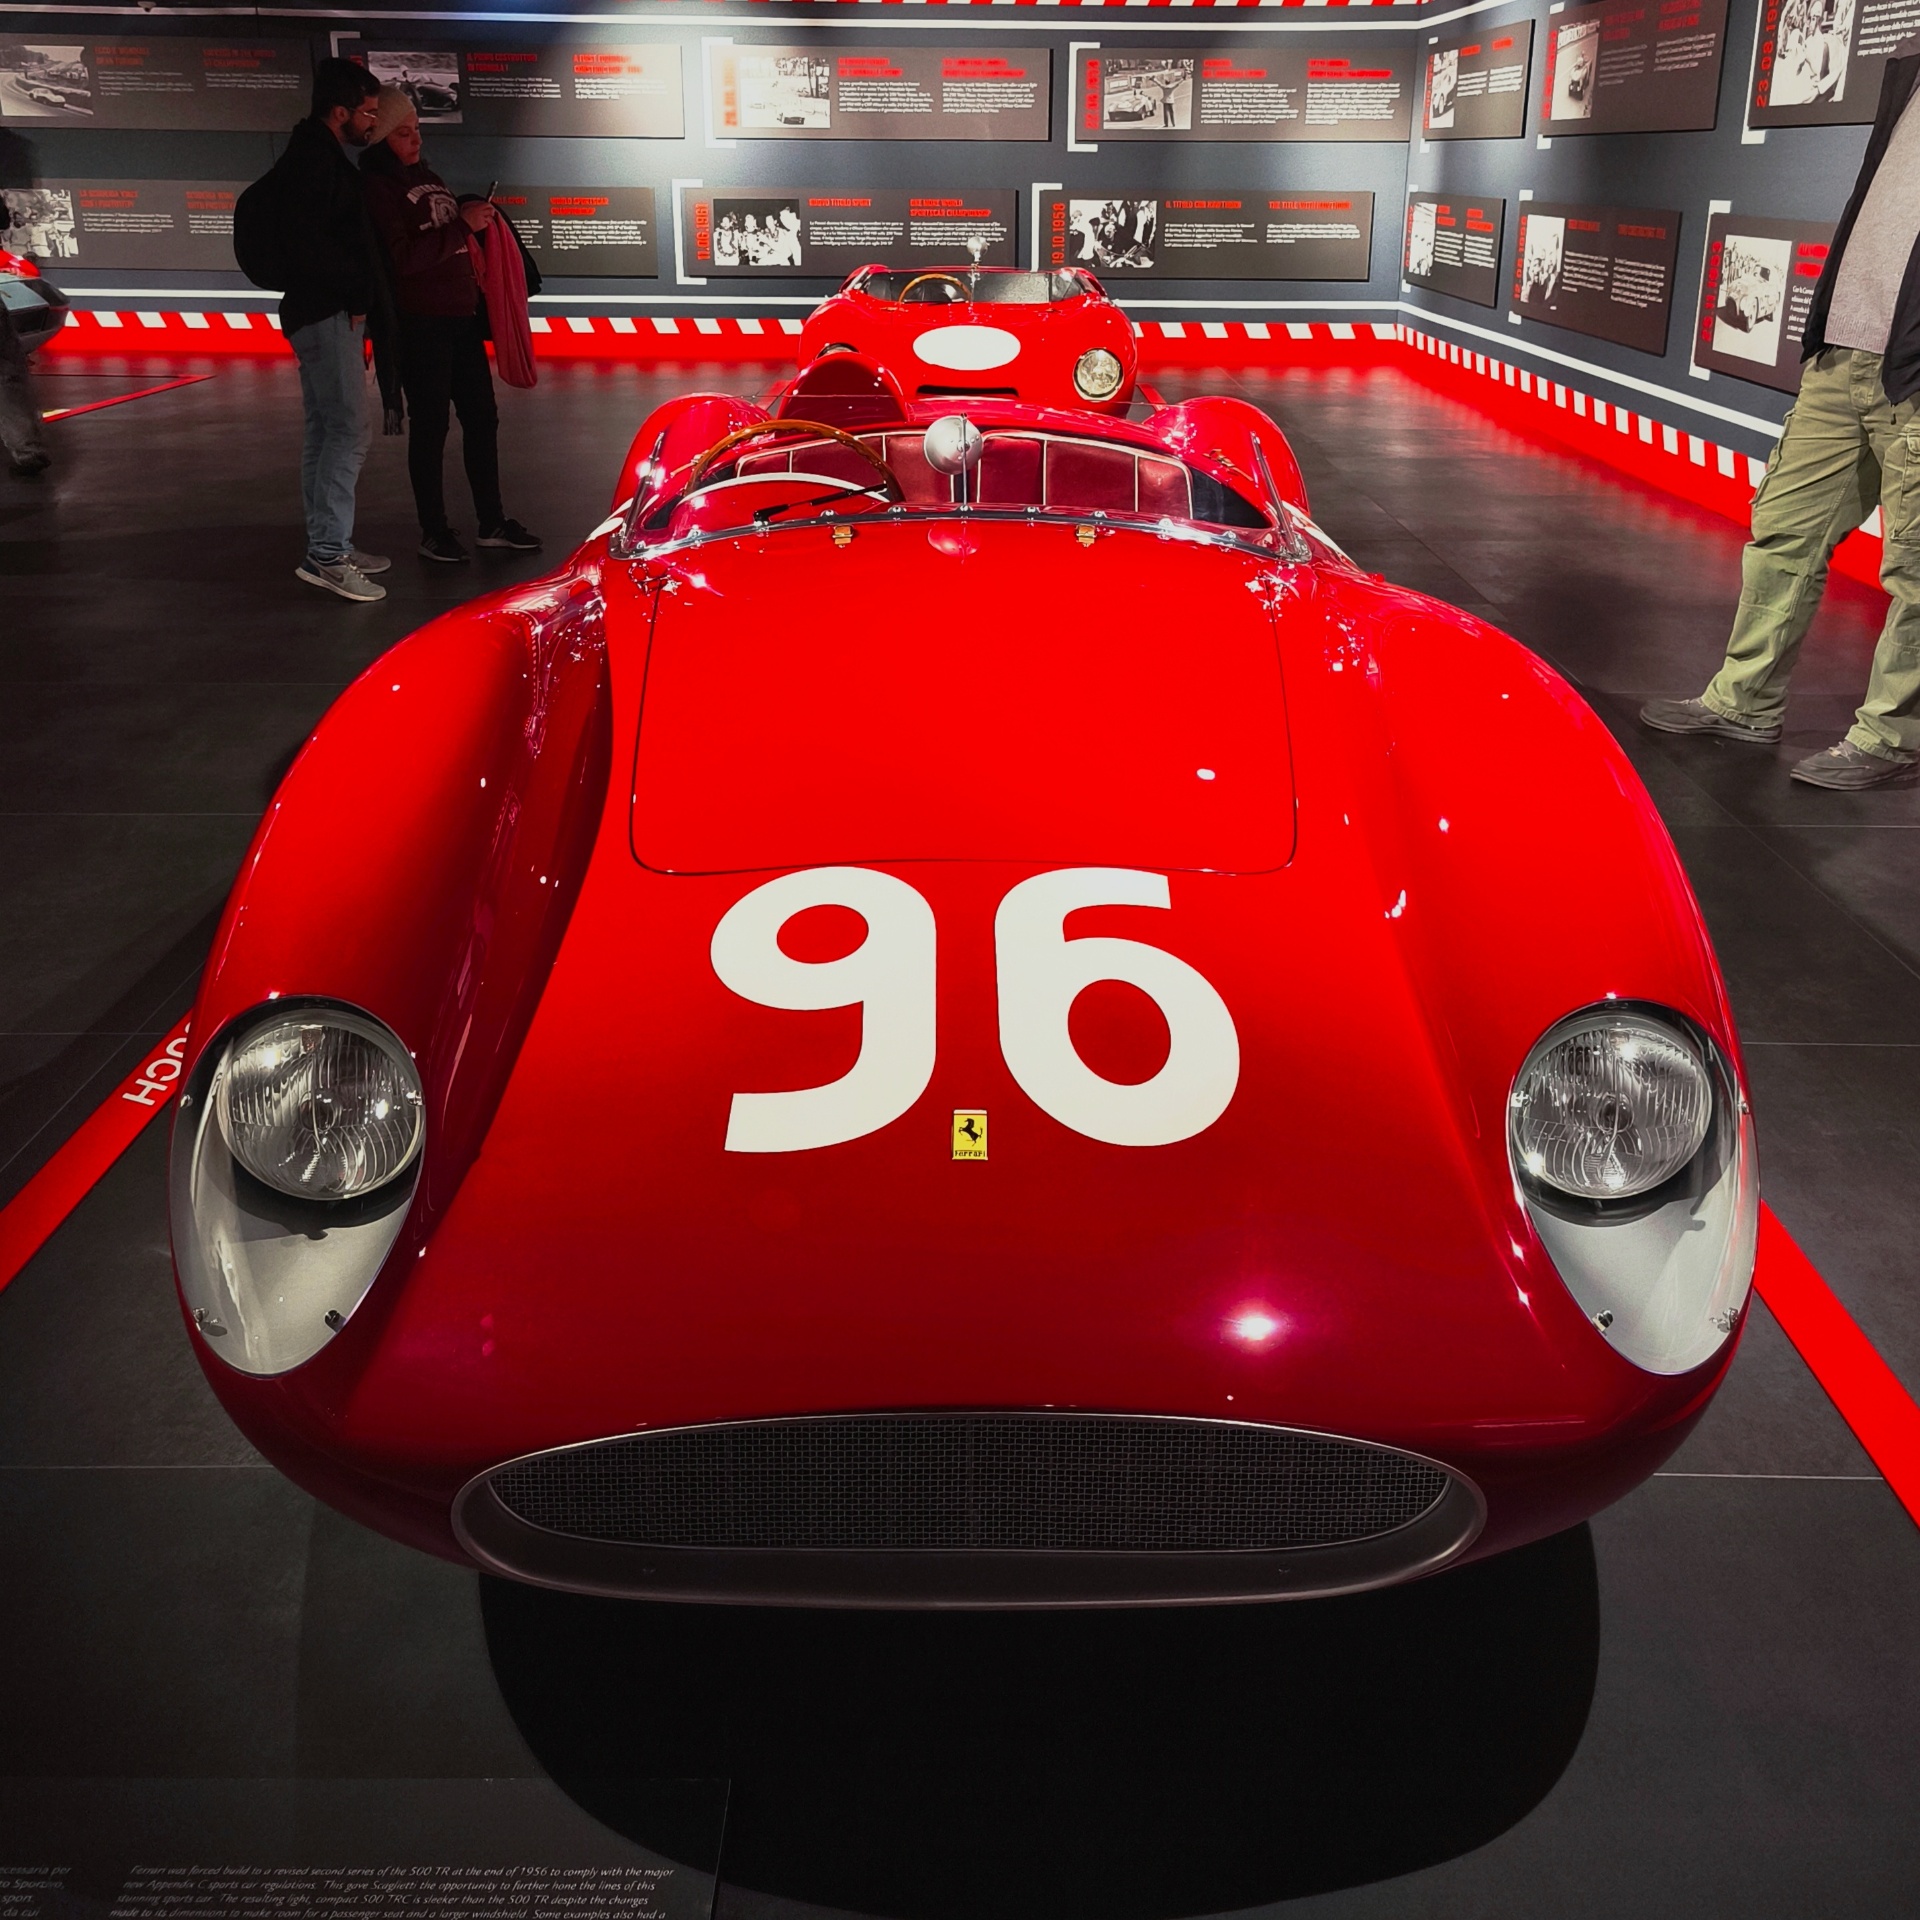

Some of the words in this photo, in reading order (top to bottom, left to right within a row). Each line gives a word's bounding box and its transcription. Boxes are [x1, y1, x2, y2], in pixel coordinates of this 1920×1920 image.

[710, 866, 1240, 1153] 96
[122, 1022, 191, 1106] UCH
[50, 1866, 72, 1878] per
[129, 1865, 165, 1875] Ferrari
[168, 1867, 186, 1875] was
[187, 1865, 221, 1878] forced
[223, 1865, 250, 1875] build
[251, 1866, 262, 1875] to
[273, 1865, 309, 1875] revised
[311, 1865, 345, 1876] second
[346, 1867, 374, 1876] series
[377, 1866, 392, 1879] of
[390, 1866, 406, 1876] the
[409, 1866, 432, 1876] 500
[435, 1866, 450, 1876] TR
[452, 1867, 462, 1876] at
[465, 1866, 480, 1876] the
[484, 1866, 502, 1876] end
[505, 1866, 520, 1879] of
[520, 1866, 548, 1876] 1956
[550, 1867, 560, 1876] to
[563, 1866, 599, 1880] comply
[601, 1866, 622, 1877] with
[625, 1866, 642, 1877] the
[644, 1868, 674, 1880] major
[123, 1881, 144, 1889] new
[147, 1878, 194, 1892] Appendix
[208, 1880, 238, 1892] sports
[241, 1881, 258, 1889] car
[323, 1879, 343, 1889] This
[344, 1882, 369, 1892] gave
[371, 1879, 418, 1893] Scaglietti
[419, 1879, 436, 1890] the
[438, 1881, 498, 1893] opportunity
[500, 1881, 510, 1890] to
[512, 1880, 548, 1893] further
[551, 1880, 576, 1890] hone
[579, 1880, 596, 1890] the
[598, 1880, 621, 1890] lines
[624, 1880, 638, 1893] of
[637, 1880, 656, 1890] this
[117, 1894, 160, 1906] stunning
[162, 1894, 192, 1906] sports
[219, 1893, 236, 1903] The
[240, 1893, 285, 1906] resulting
[315, 1894, 358, 1907] compact
[361, 1893, 384, 1904] 500
[387, 1893, 412, 1904] TRC
[412, 1895, 421, 1904] is
[423, 1894, 458, 1904] sleeker
[461, 1894, 485, 1904] than
[488, 1894, 505, 1904] the
[507, 1894, 530, 1904] 500
[534, 1894, 549, 1904] TR
[550, 1894, 587, 1907] despite
[589, 1894, 606, 1904] the
[608, 1894, 648, 1908] changes
[109, 1907, 139, 1917] made
[141, 1908, 152, 1917] to
[154, 1908, 166, 1917] its
[169, 1907, 227, 1917] dimensions
[229, 1908, 240, 1917] to
[242, 1907, 271, 1917] make
[302, 1907, 320, 1920] for
[328, 1910, 380, 1920] passenger
[383, 1909, 404, 1918] seat
[406, 1908, 428, 1918] and
[439, 1908, 470, 1920] larger
[532, 1908, 561, 1918] Some
[563, 1908, 611, 1920] examples
[613, 1909, 634, 1919] also
[637, 1909, 660, 1919] had
